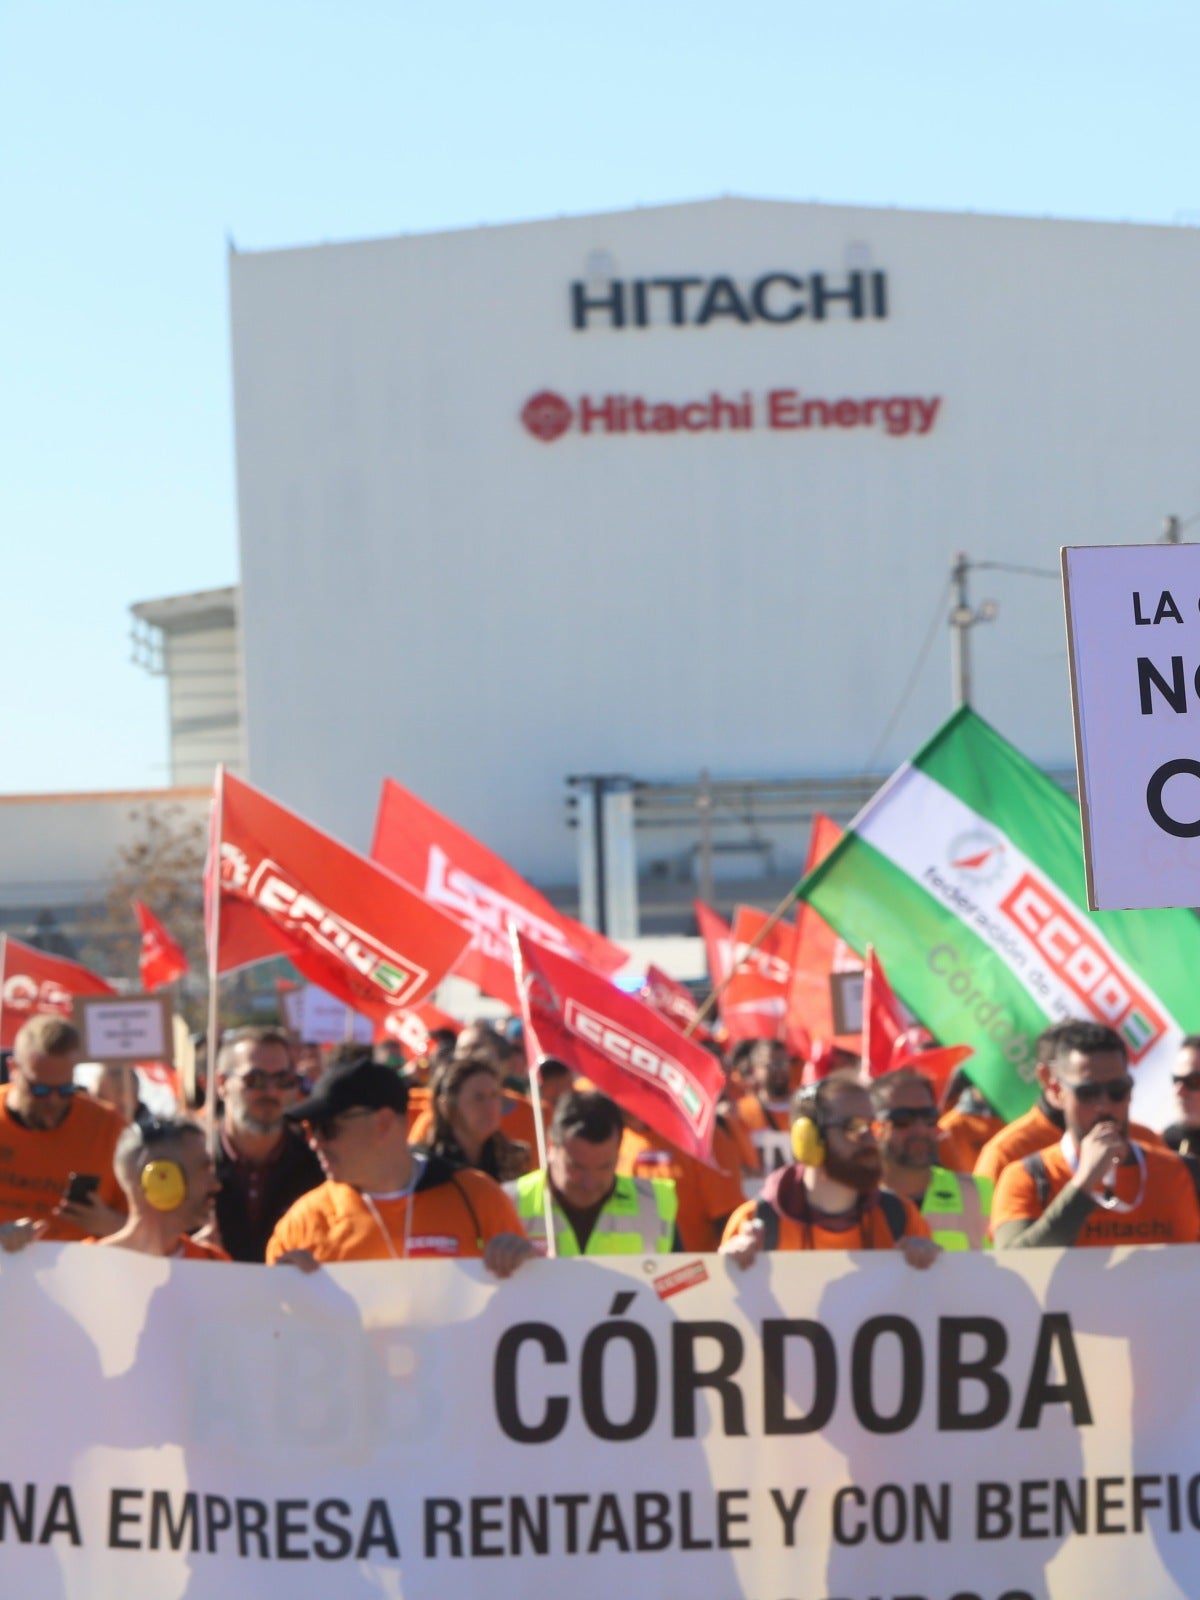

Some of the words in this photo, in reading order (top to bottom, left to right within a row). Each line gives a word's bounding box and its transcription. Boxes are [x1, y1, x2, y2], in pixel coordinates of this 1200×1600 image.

[570, 269, 888, 331] HITACHI
[580, 391, 752, 434] Hitachi
[767, 390, 942, 437] Energy
[1132, 590, 1184, 626] LA
[1009, 887, 1132, 1022] CCOO
[492, 1291, 1095, 1445] CÓRDOBA
[107, 1489, 401, 1561] EMPRESA
[423, 1489, 751, 1559] RENTABLE
[769, 1488, 808, 1548] Y
[831, 1482, 951, 1546] CON
